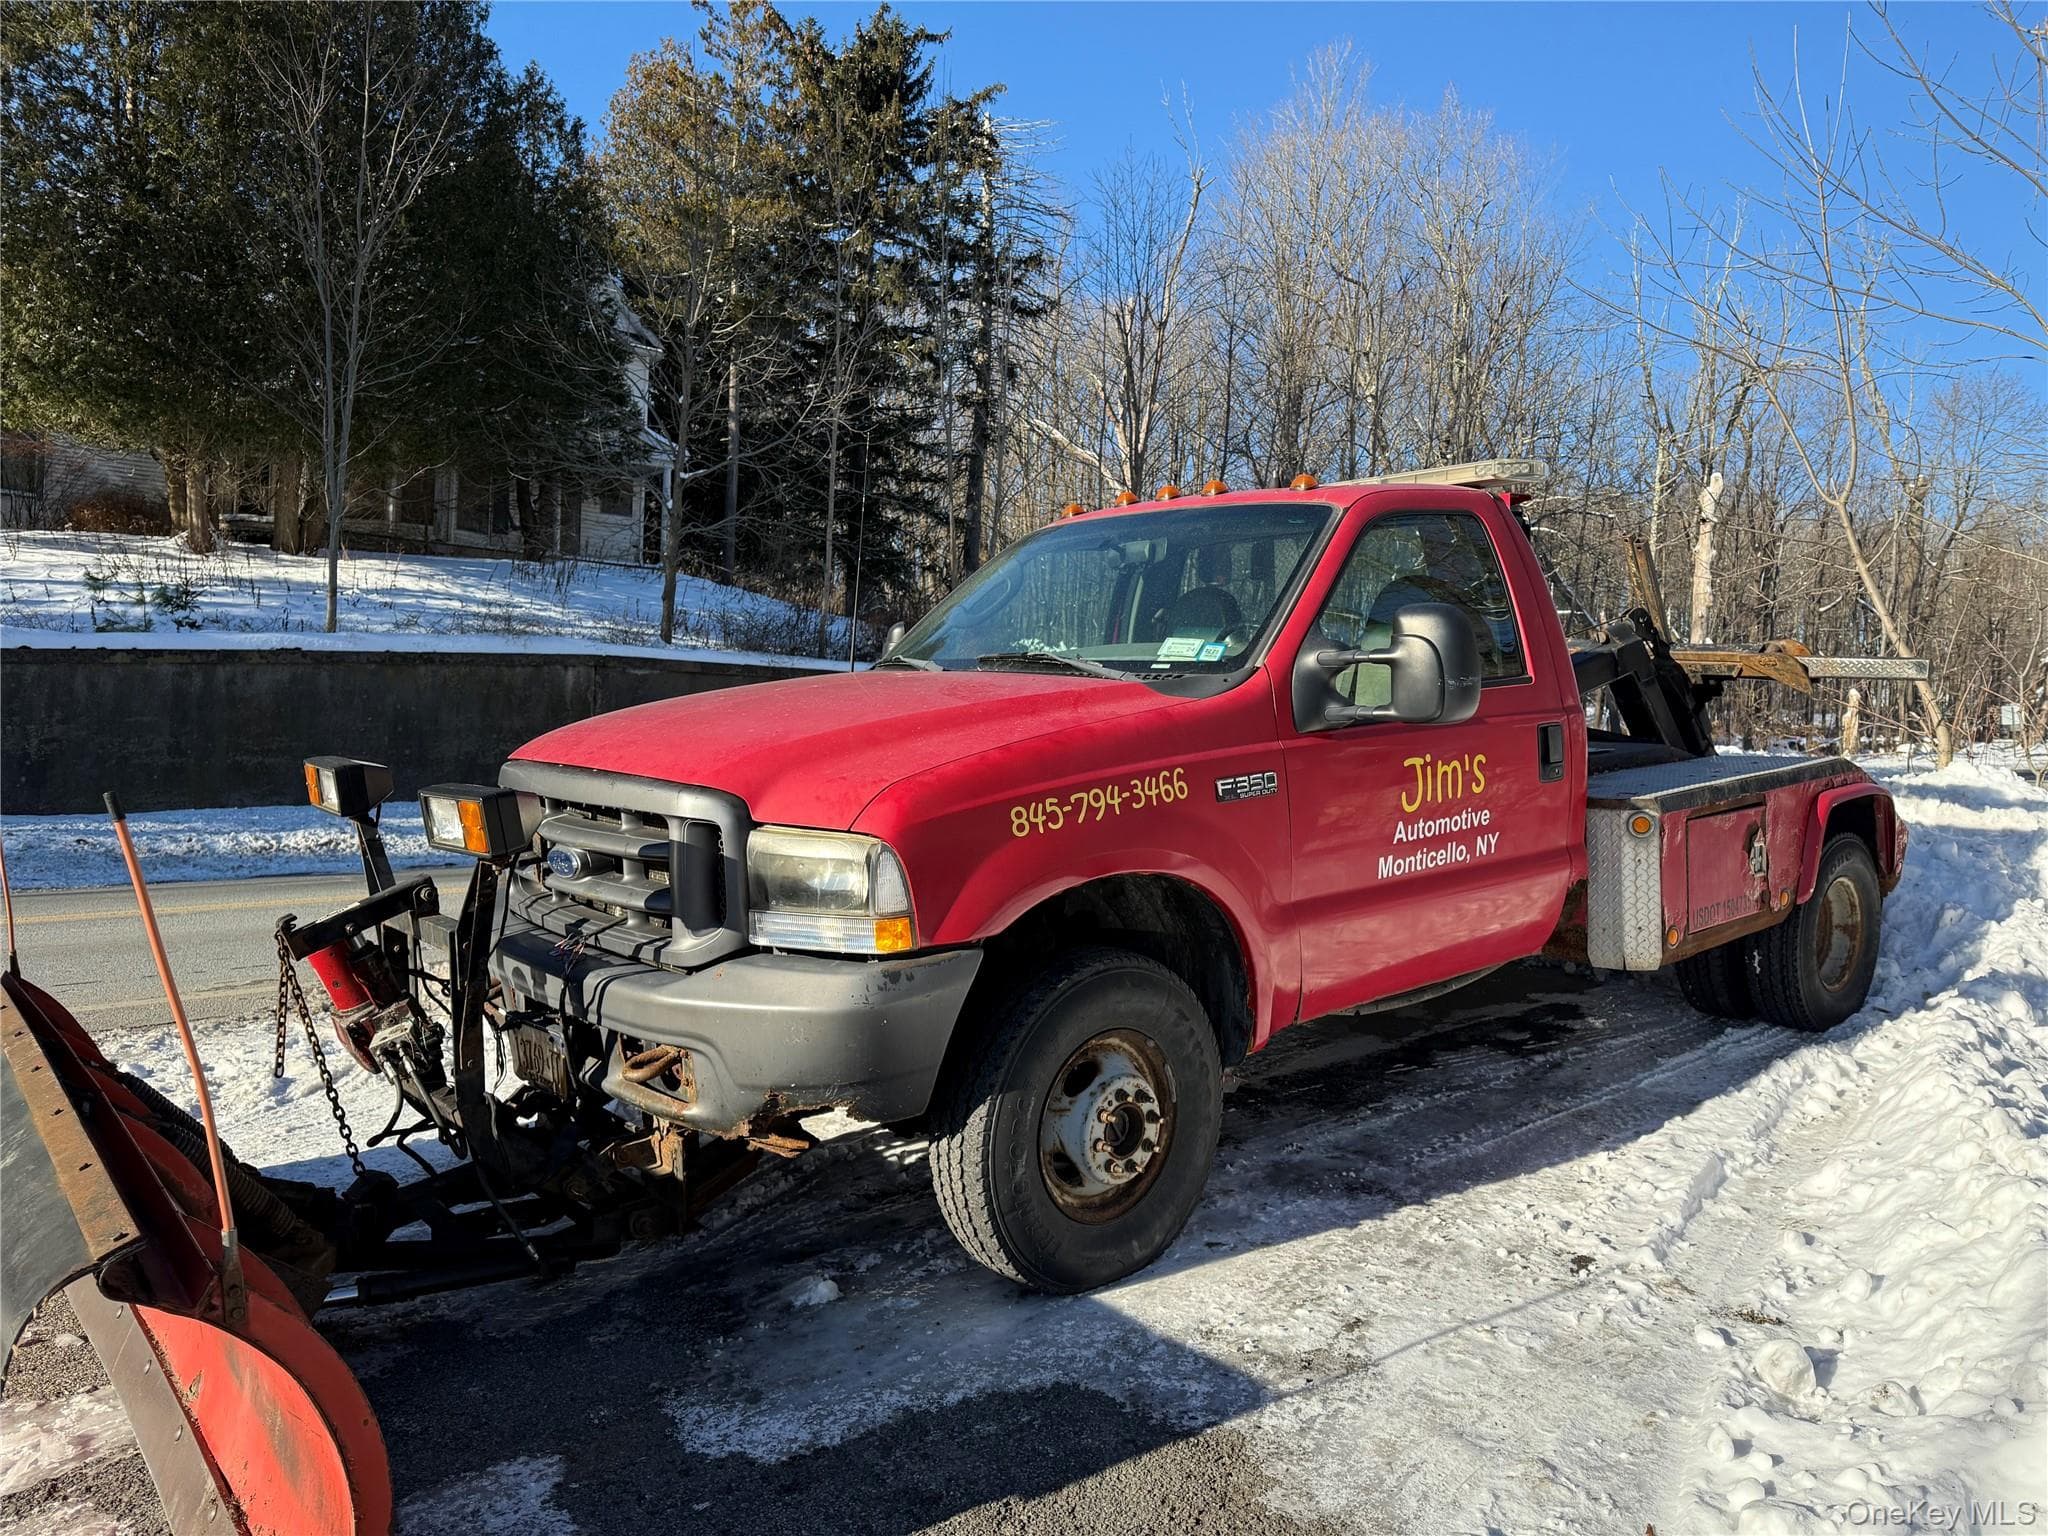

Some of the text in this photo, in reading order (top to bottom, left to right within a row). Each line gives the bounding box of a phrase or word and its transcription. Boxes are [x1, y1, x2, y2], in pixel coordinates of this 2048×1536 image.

[1010, 767, 1189, 837] 845-794-3466
[1239, 787, 1279, 799] SUPER DUTY
[1401, 753, 1487, 813] Jim's
[1393, 807, 1491, 845] Automotive
[1377, 831, 1500, 880] Monticello, NY
